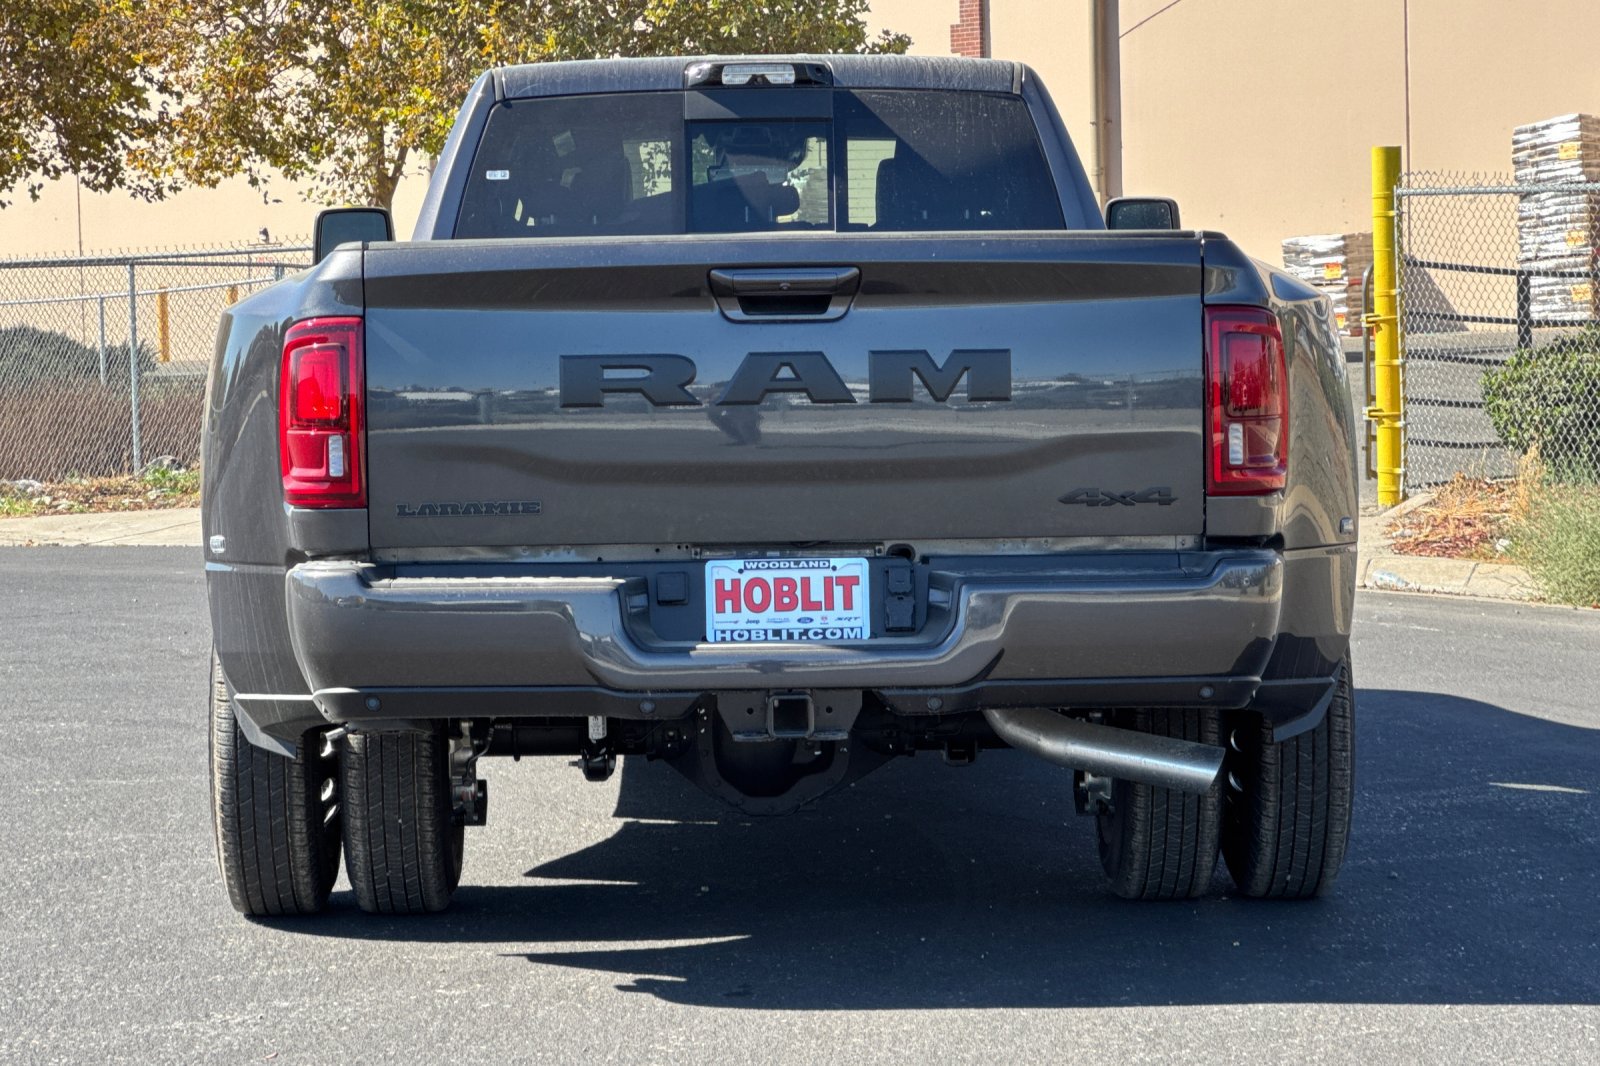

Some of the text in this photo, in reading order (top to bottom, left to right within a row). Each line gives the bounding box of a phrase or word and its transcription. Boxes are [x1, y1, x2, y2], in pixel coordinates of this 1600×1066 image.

[559, 348, 1011, 408] RAM
[397, 501, 541, 517] LARAMIE
[745, 561, 830, 569] WOODLAND
[715, 576, 860, 614] HOBLIT
[715, 628, 862, 641] HOBLIT.COM
